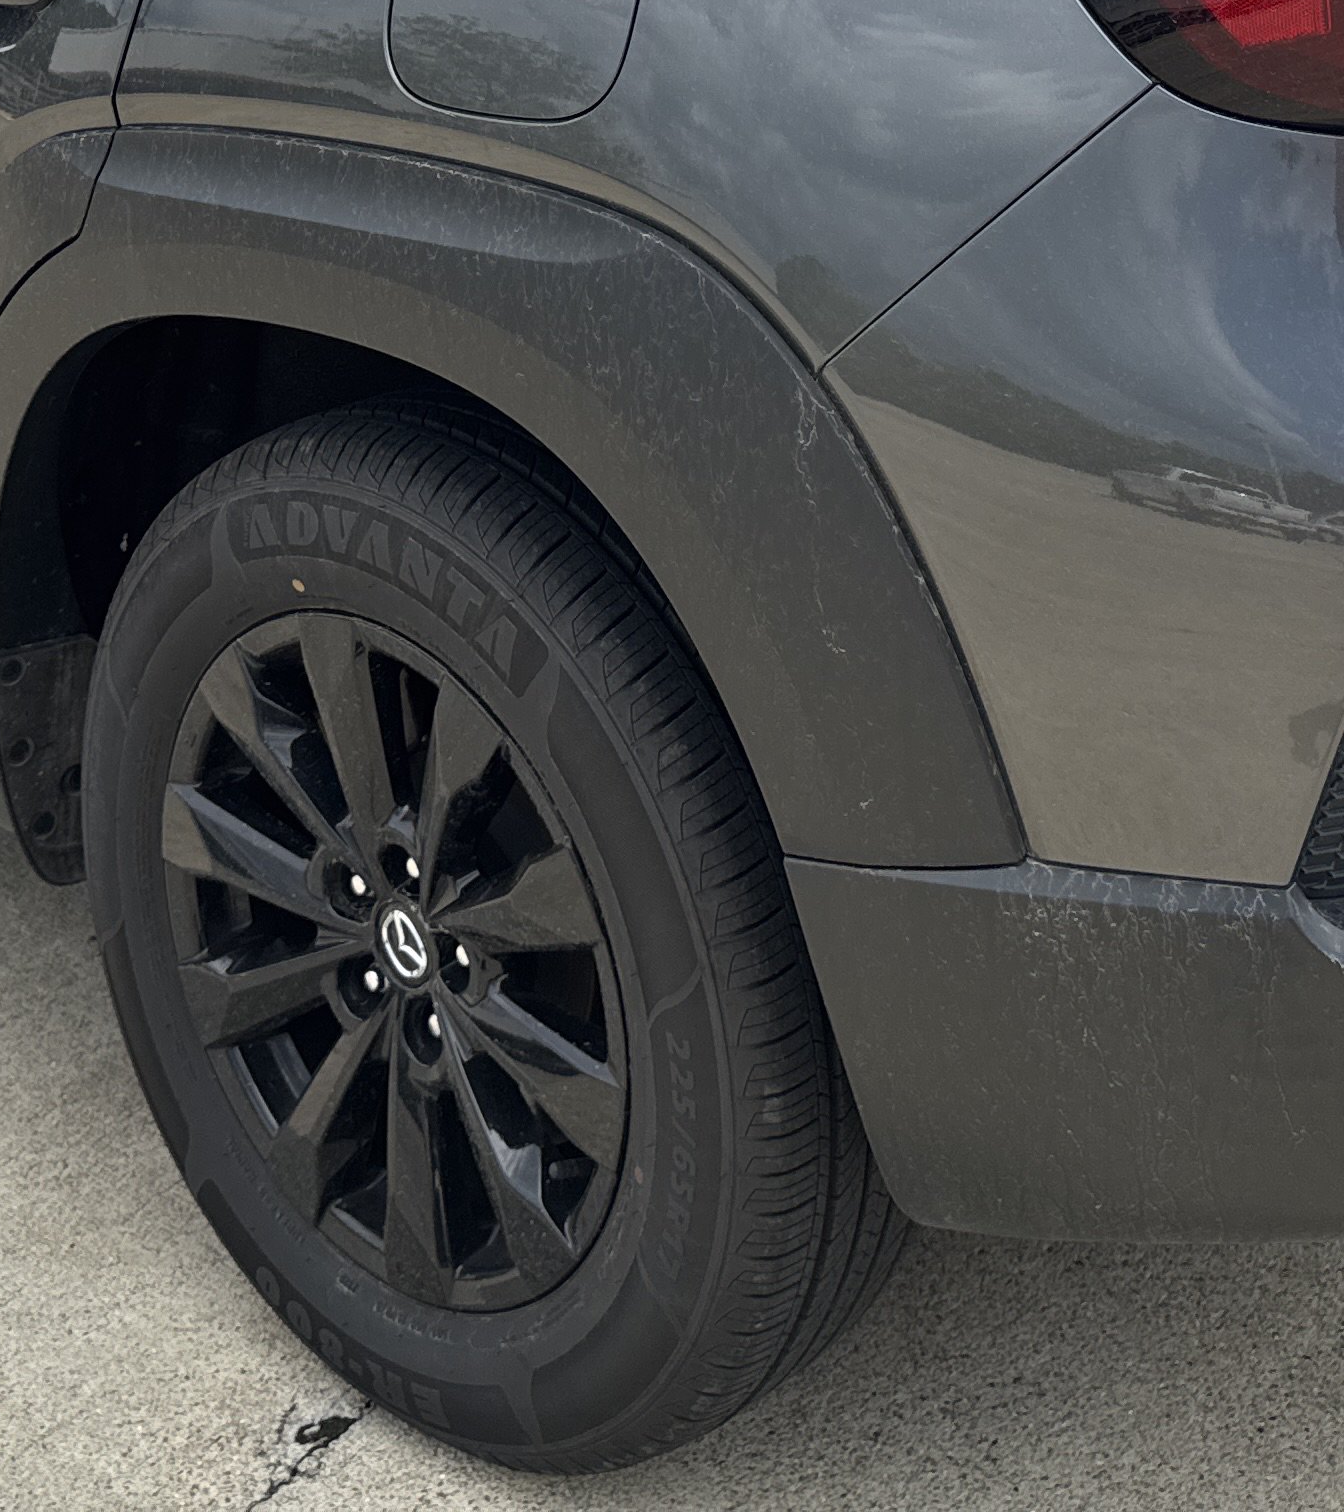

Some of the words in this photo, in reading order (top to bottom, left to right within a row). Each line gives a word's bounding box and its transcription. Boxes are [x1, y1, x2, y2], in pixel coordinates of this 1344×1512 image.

[248, 499, 519, 672] ADVANTA
[657, 1031, 697, 1282] 225/65R17
[255, 1265, 453, 1431] ER-800
